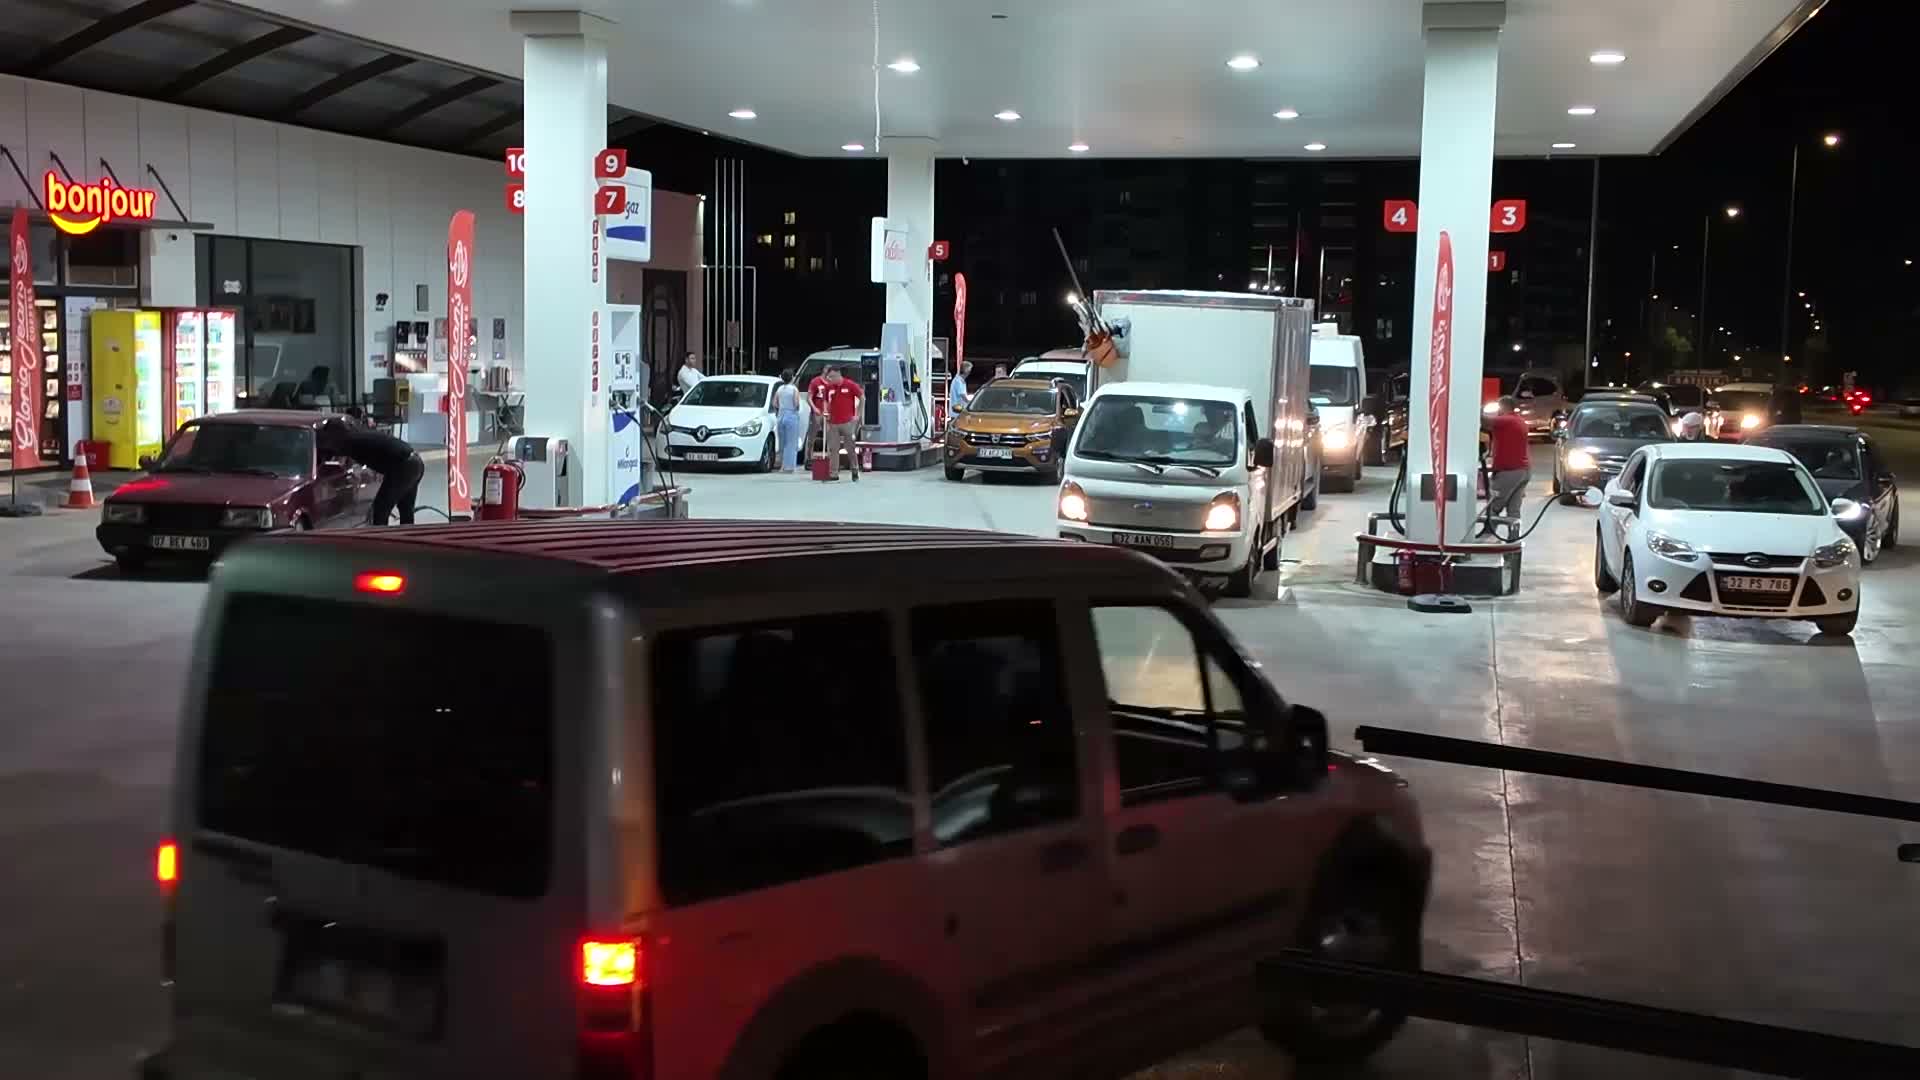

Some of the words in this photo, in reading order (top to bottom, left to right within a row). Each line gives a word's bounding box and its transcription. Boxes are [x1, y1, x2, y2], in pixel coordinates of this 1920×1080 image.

[605, 154, 619, 173] 9
[46, 171, 155, 222] bonjour
[513, 189, 525, 208] 8
[605, 191, 618, 209] 7
[1391, 207, 1408, 226] 4
[1501, 206, 1517, 226] 3
[1491, 256, 1498, 268] 1
[15, 367, 38, 456] Gloria
[1120, 534, 1130, 544] 32
[1730, 577, 1743, 588] 32
